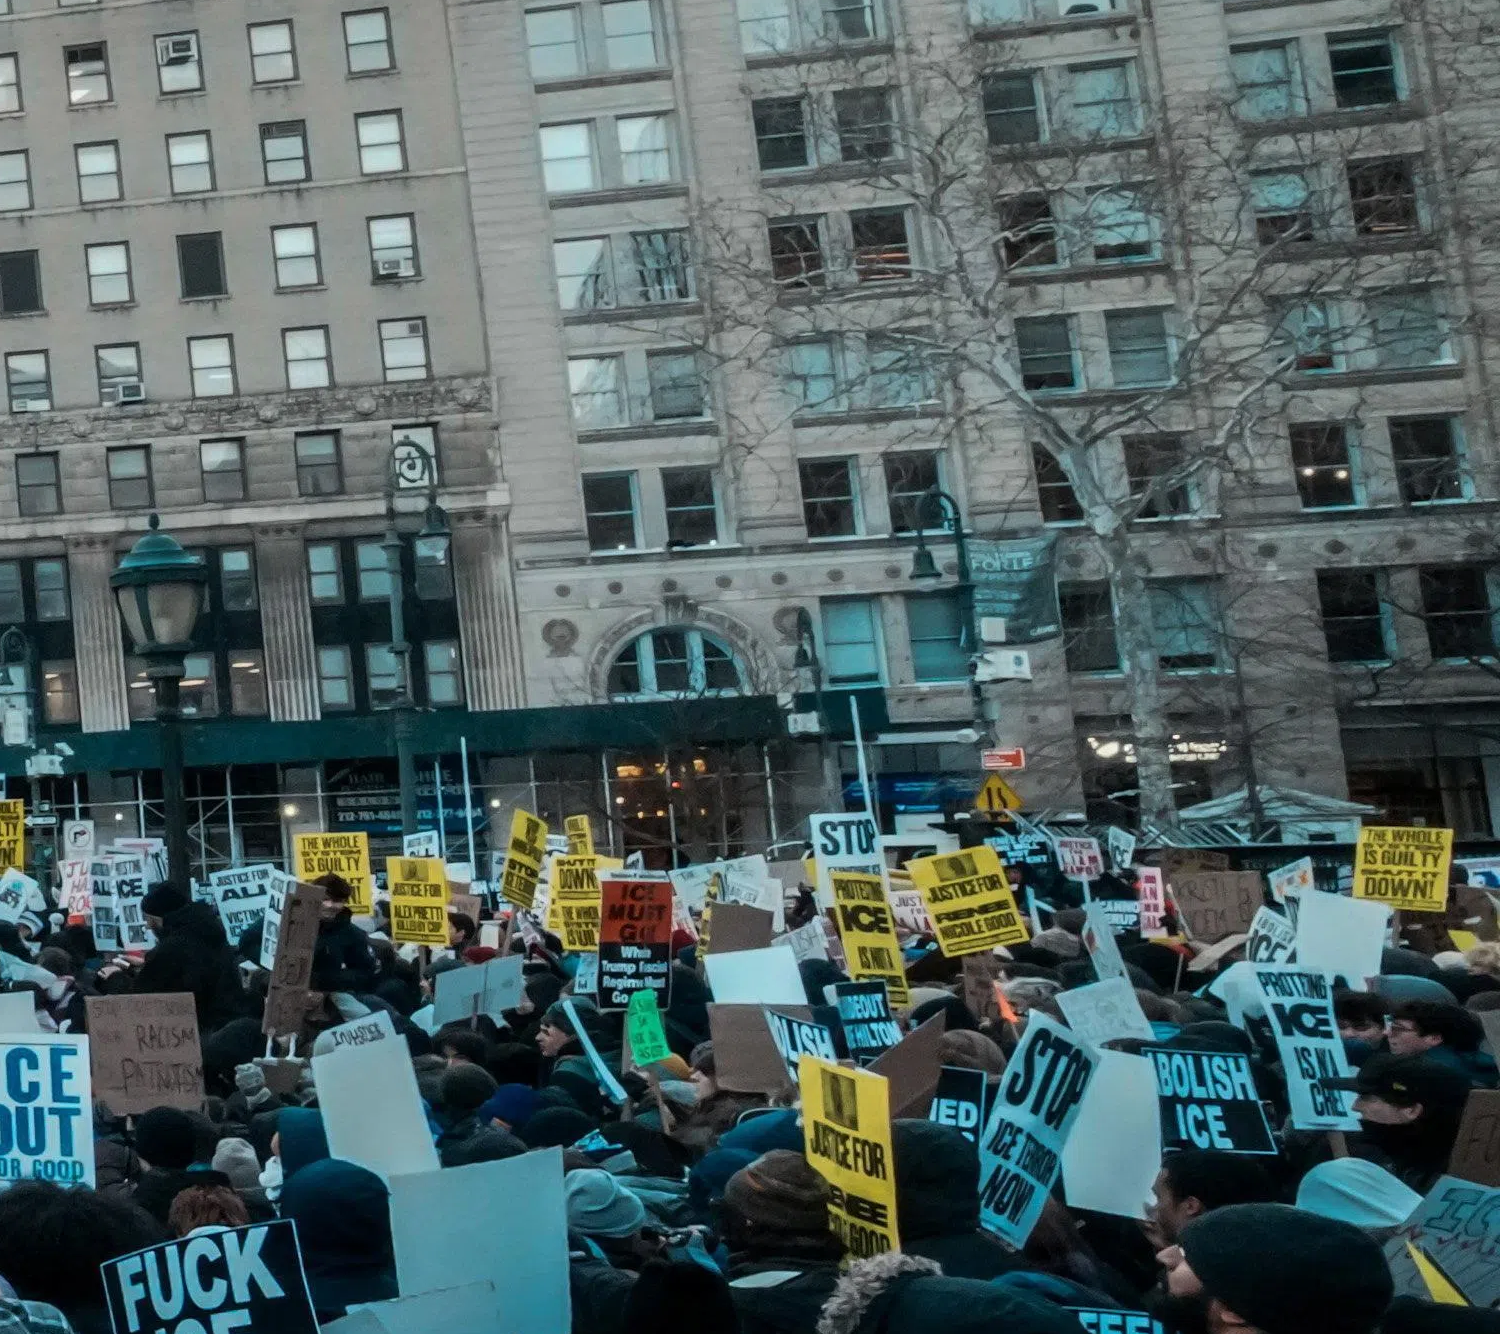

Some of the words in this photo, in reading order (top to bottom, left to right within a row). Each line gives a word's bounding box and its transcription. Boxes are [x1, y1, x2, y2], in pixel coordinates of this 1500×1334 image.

[301, 837, 319, 849] THE
[321, 836, 359, 848] WHOLE
[819, 818, 875, 855] STOP
[1367, 829, 1390, 842] THE
[1392, 830, 1443, 843] WHOLE
[302, 858, 315, 872] IS
[317, 857, 360, 872] GUILTY
[1364, 850, 1377, 865] IS
[1381, 851, 1442, 867] GUILTY
[116, 880, 144, 897] ICE
[217, 872, 252, 886] JUSTICE
[928, 878, 978, 903] JUSTICE
[978, 873, 1003, 894] FOR
[1364, 877, 1435, 900] DOWN!
[226, 908, 265, 925] VICTIMS
[412, 906, 444, 921] PRETTI
[840, 904, 891, 934] ICE
[940, 917, 985, 940] NICOLE
[987, 911, 1016, 932] GOOD
[602, 960, 636, 975] Trump
[611, 991, 628, 1004] Go
[1271, 1003, 1335, 1039] ICE
[136, 1023, 197, 1050] RACISM
[1293, 1046, 1316, 1080] IS
[1005, 1027, 1092, 1131] STOP
[1176, 1104, 1234, 1149] ICE
[810, 1120, 853, 1171] JUSTICE
[853, 1135, 887, 1181] FOR
[986, 1118, 1023, 1161] ICE
[33, 1160, 85, 1180] GOOD
[117, 1226, 284, 1334] FUCK
